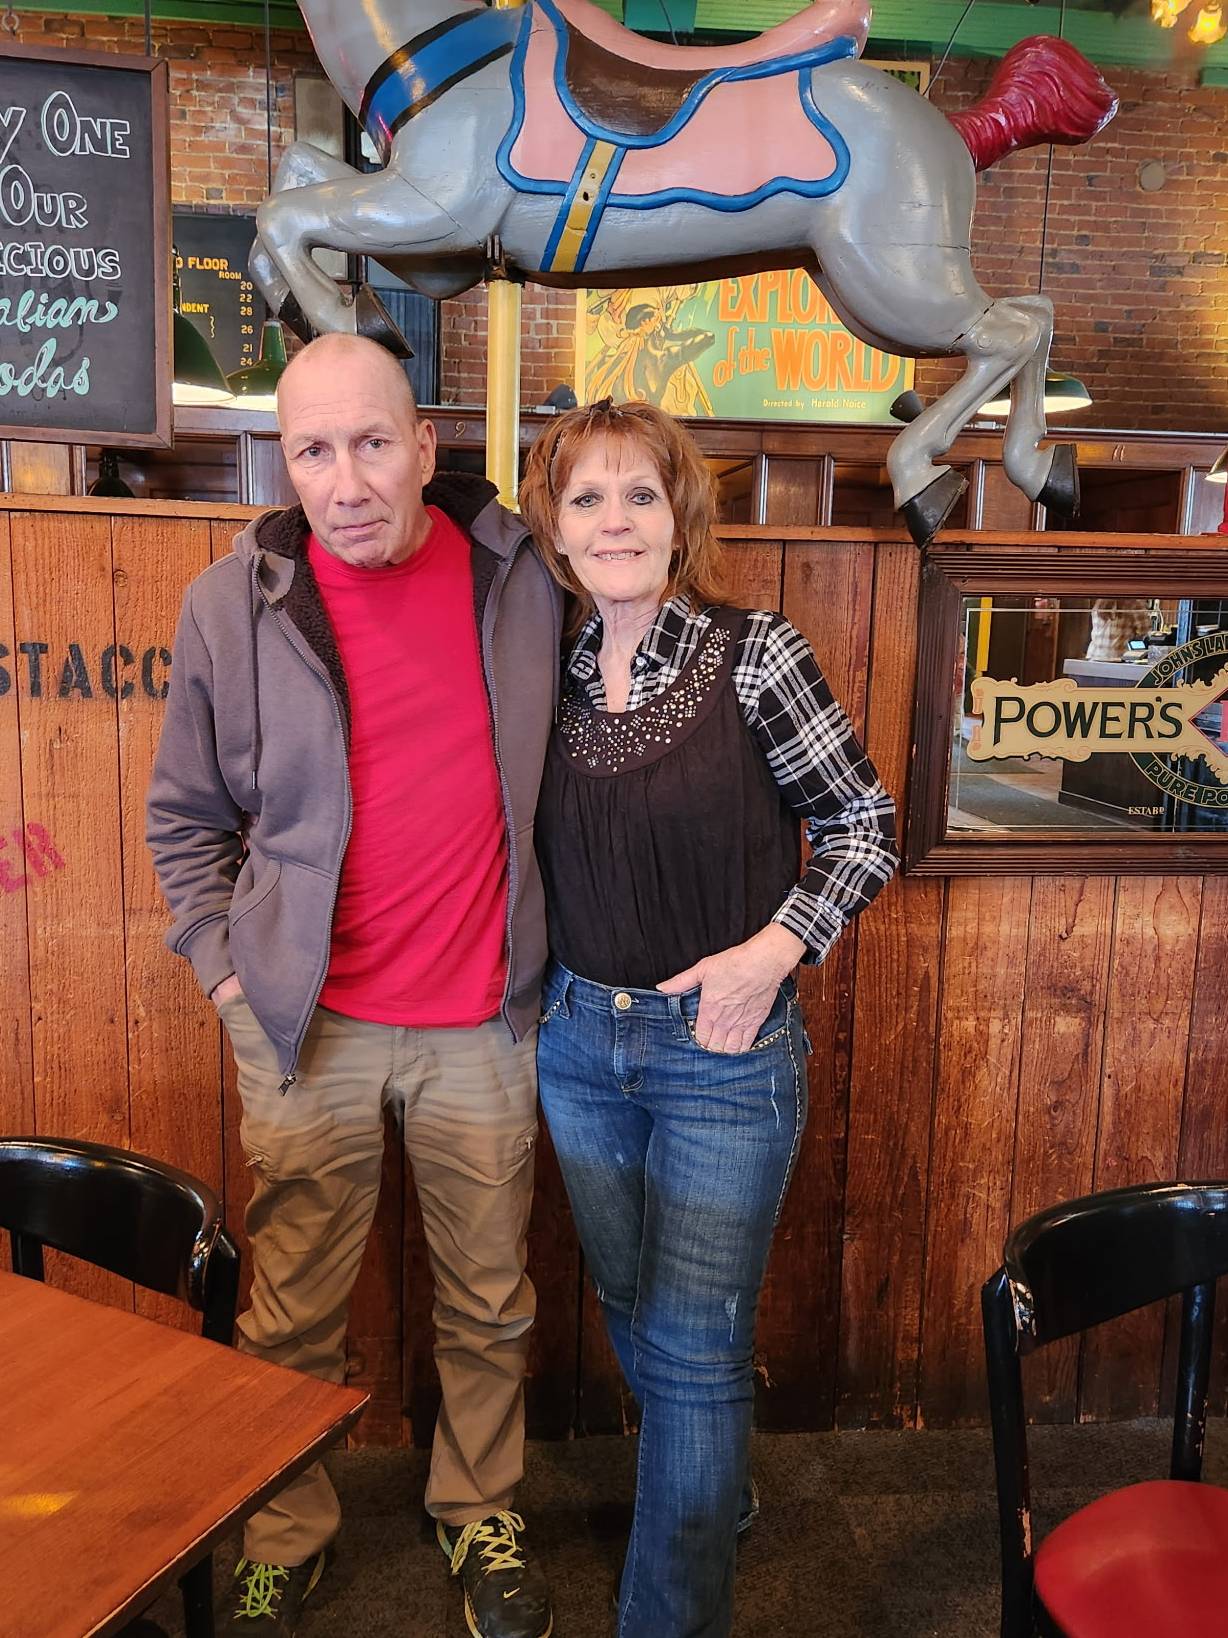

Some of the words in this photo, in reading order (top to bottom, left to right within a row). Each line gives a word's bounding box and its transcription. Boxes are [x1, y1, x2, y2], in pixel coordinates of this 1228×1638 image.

[187, 256, 229, 271] FLOOR
[218, 270, 242, 281] ROOM
[240, 280, 253, 291] 20
[240, 293, 253, 303] 22
[240, 306, 253, 316] 28
[240, 324, 254, 335] 26
[242, 343, 253, 353] 21
[240, 357, 253, 367] 24
[713, 325, 740, 389] of
[737, 328, 772, 376] the
[769, 327, 902, 393] WORLD
[763, 398, 795, 409] Directed
[796, 399, 806, 410] by
[811, 398, 839, 410] Harold
[842, 398, 867, 410] Noice
[993, 696, 1183, 746] POWER'S
[1143, 759, 1199, 802] PURE
